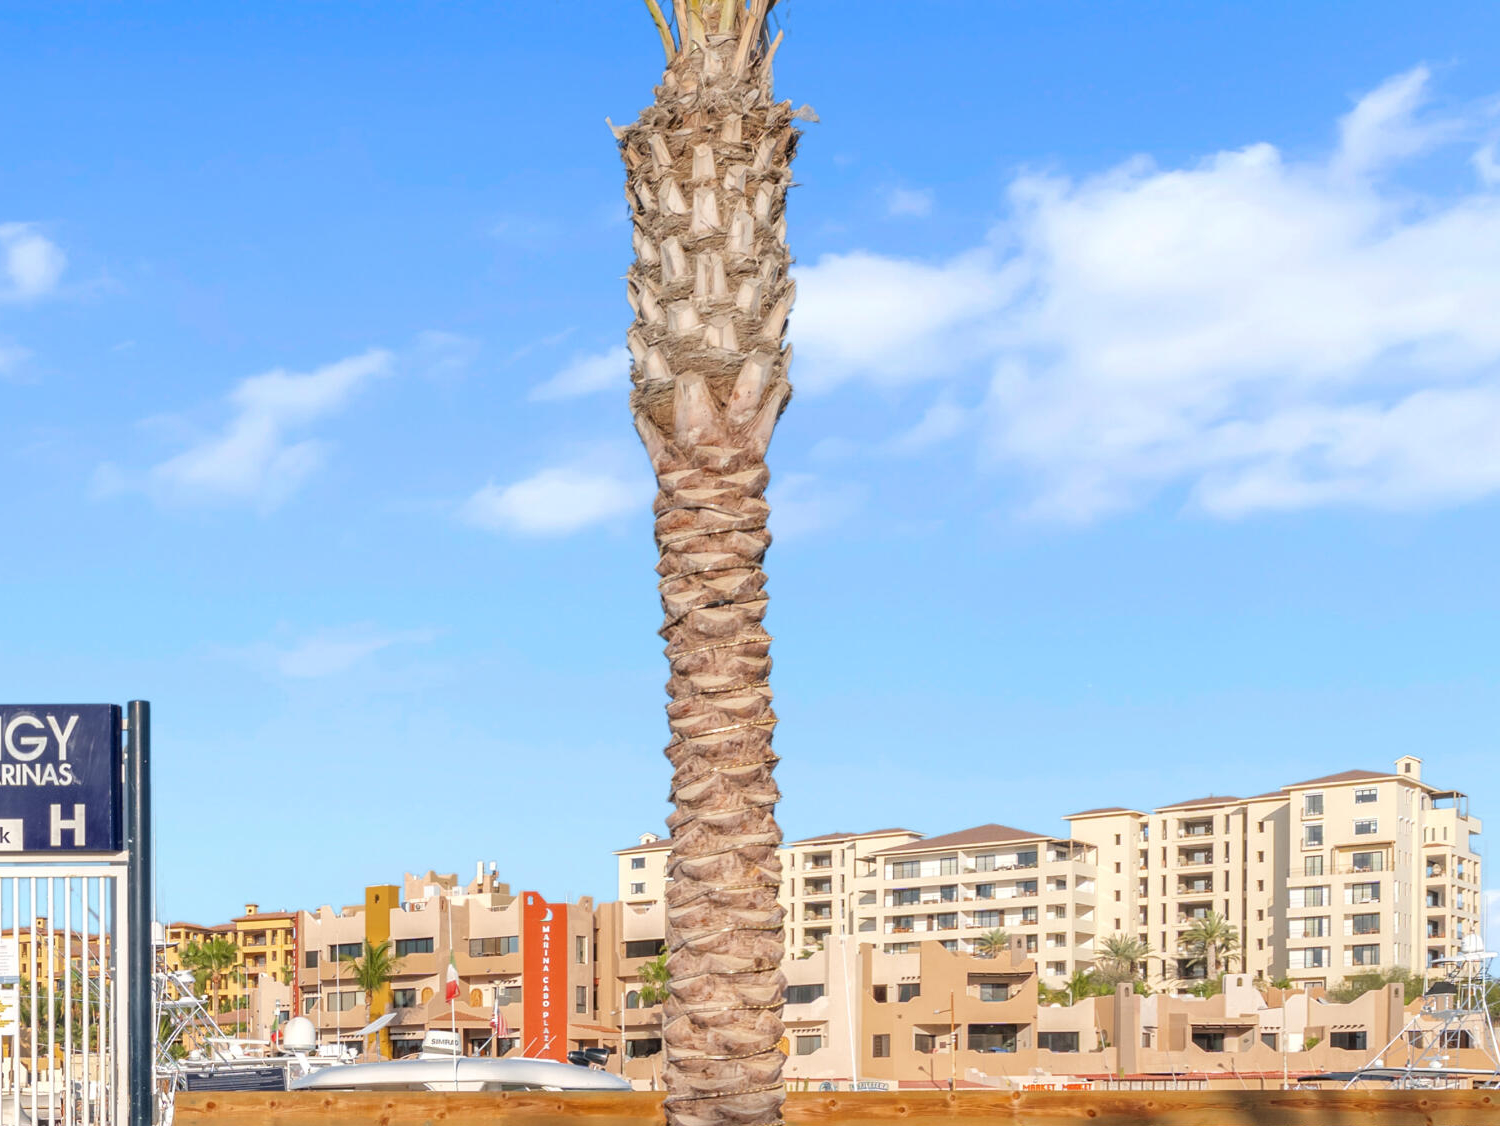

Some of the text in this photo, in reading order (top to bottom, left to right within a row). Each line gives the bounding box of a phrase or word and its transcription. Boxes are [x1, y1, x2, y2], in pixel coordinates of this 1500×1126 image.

[50, 803, 86, 847] H
[542, 925, 550, 1050] MARINA CABO PLAZA
